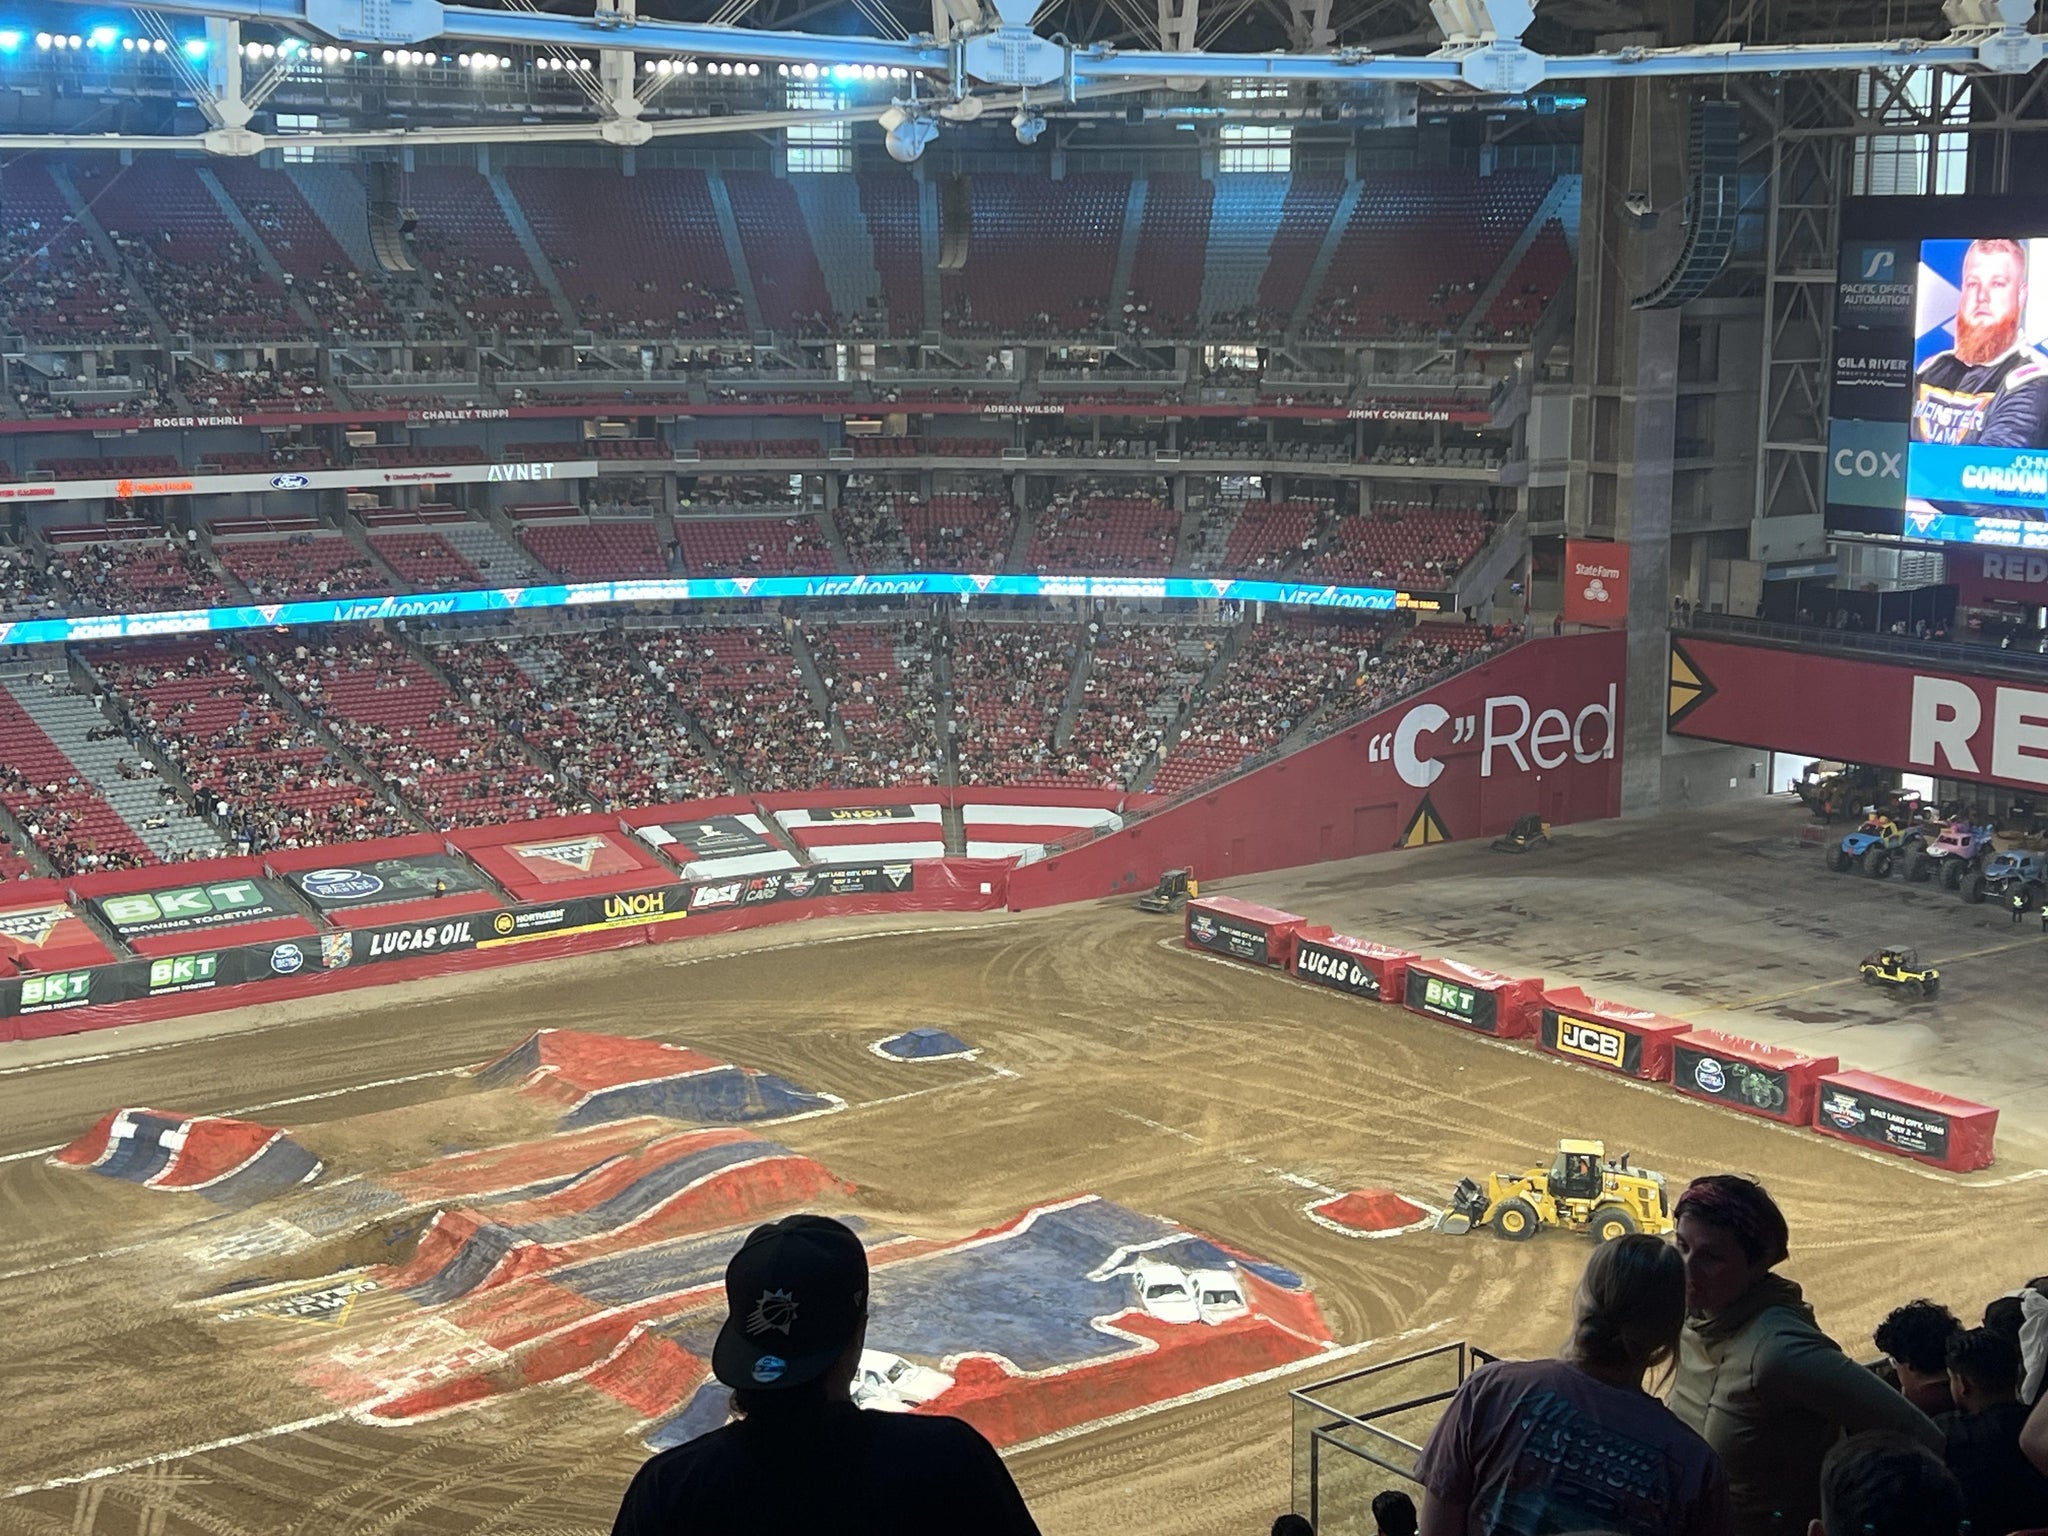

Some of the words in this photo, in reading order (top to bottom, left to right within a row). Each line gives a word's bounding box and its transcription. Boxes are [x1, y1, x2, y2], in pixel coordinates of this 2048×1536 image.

[1840, 284, 1876, 294] PACIFIC
[1879, 284, 1914, 294] OFFICE
[1844, 295, 1910, 305] AUTOMATION
[1837, 357, 1866, 369] GILA
[1868, 358, 1907, 370] RIVER
[422, 410, 472, 421] CHARLEY
[474, 408, 510, 419] TRIPPI
[984, 405, 1022, 413] ADRIAN
[1025, 405, 1065, 414] WILSON
[1347, 409, 1380, 419] JIMMY
[1382, 410, 1449, 421] CONZELMAN
[153, 417, 194, 428] ROGER
[196, 416, 243, 426] WEHRLI
[487, 463, 555, 482] AVNET
[1834, 448, 1902, 479] COX
[1983, 552, 2048, 582] RED
[1481, 683, 1617, 777] Red
[106, 883, 256, 921] BKT
[604, 892, 665, 918] UNOH
[746, 888, 778, 901] CARS
[192, 906, 273, 924] TOGETHER
[369, 927, 437, 956] LUCAS
[151, 955, 216, 985] BKT
[1298, 949, 1349, 982] LUCAS
[22, 975, 90, 1001] BKT
[1426, 981, 1475, 1011] BKT
[1563, 1026, 1619, 1058] JCB
[1924, 1122, 1944, 1135] UTAH
